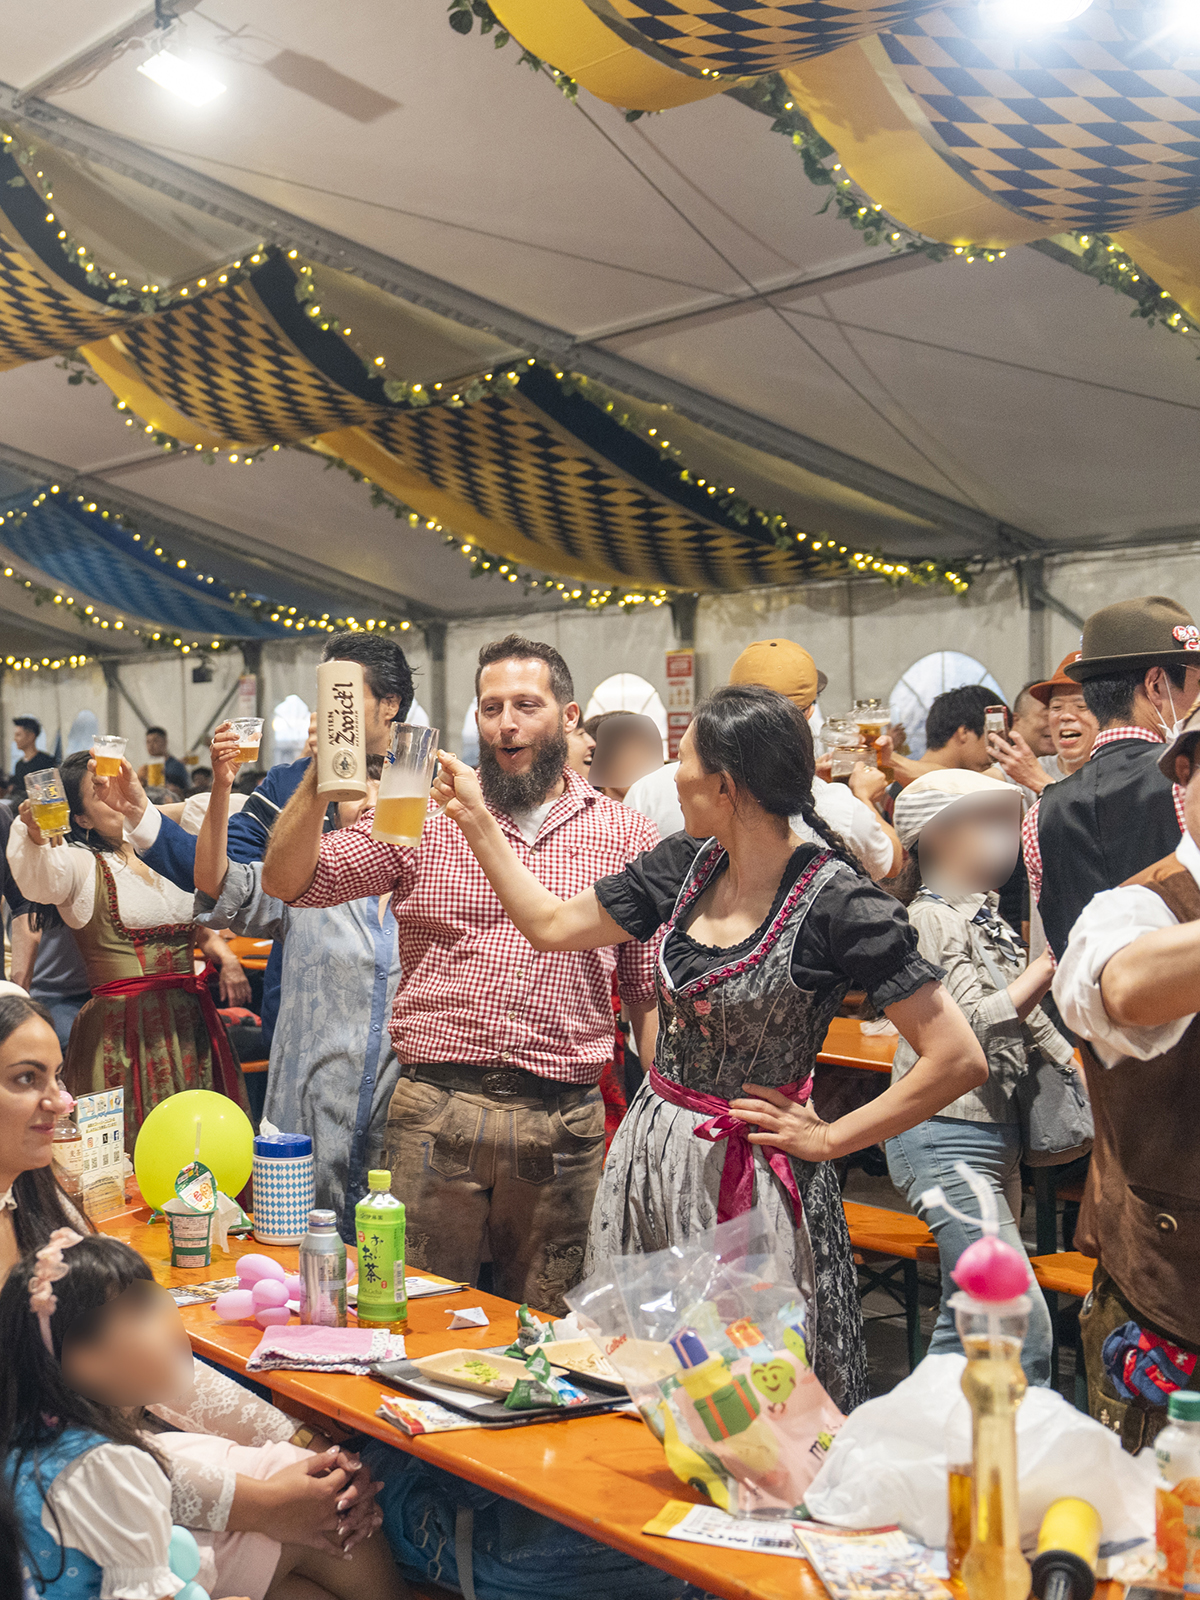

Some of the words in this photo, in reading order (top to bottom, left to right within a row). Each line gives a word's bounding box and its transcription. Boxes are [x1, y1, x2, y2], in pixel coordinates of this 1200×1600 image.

[327, 711, 335, 746] AKTIEN
[332, 681, 354, 747] Zwick'l
[605, 1333, 627, 1355] Calbee
